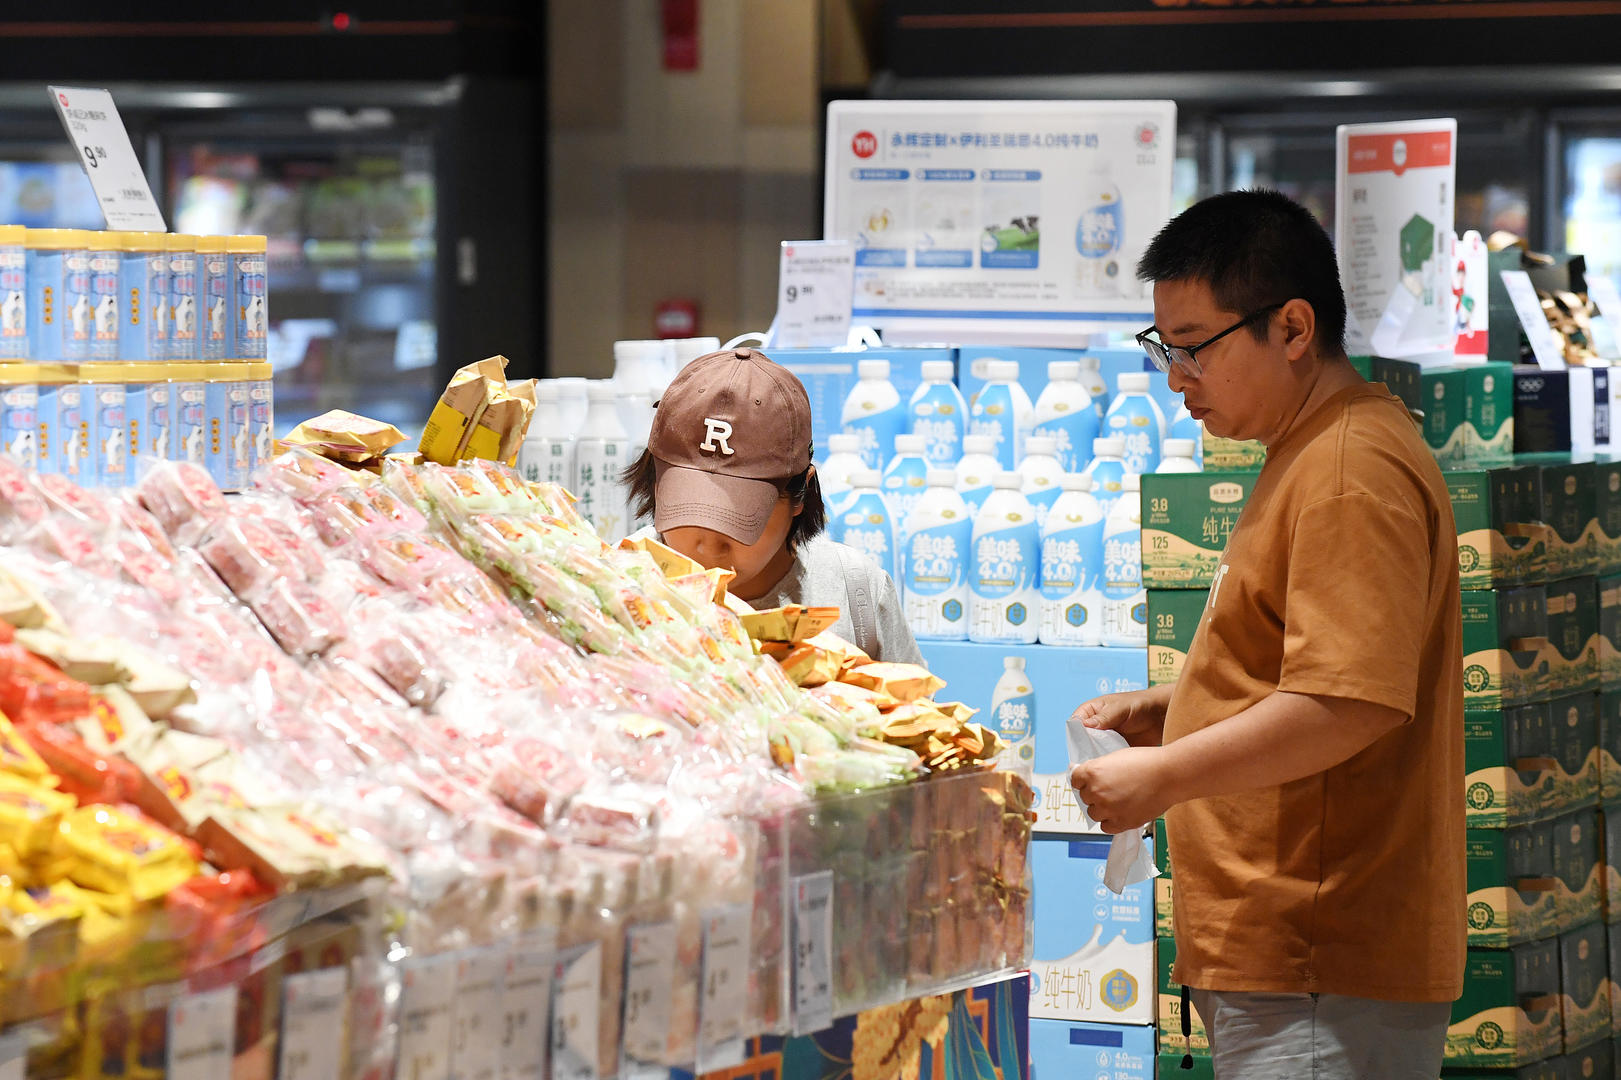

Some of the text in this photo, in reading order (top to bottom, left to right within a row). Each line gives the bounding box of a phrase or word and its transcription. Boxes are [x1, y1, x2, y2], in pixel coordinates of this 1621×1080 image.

[84, 146, 98, 168] 9
[786, 285, 798, 303] 9
[700, 417, 734, 455] R
[1151, 497, 1168, 512] 3.8
[912, 533, 958, 560] 美味
[977, 536, 1023, 563] 美味
[1043, 538, 1082, 564] 美味
[1152, 536, 1169, 549] 125
[913, 559, 948, 577] 4.0
[978, 561, 1013, 579] 4.0
[1043, 563, 1073, 581] 4.0
[1105, 564, 1137, 581] 4.0
[1156, 614, 1174, 628] 3.8
[1158, 652, 1174, 665] 125
[999, 702, 1029, 719] 美味
[1000, 718, 1024, 730] 4.0
[1044, 965, 1092, 1010] 纯牛奶
[1169, 1001, 1182, 1015] 12
